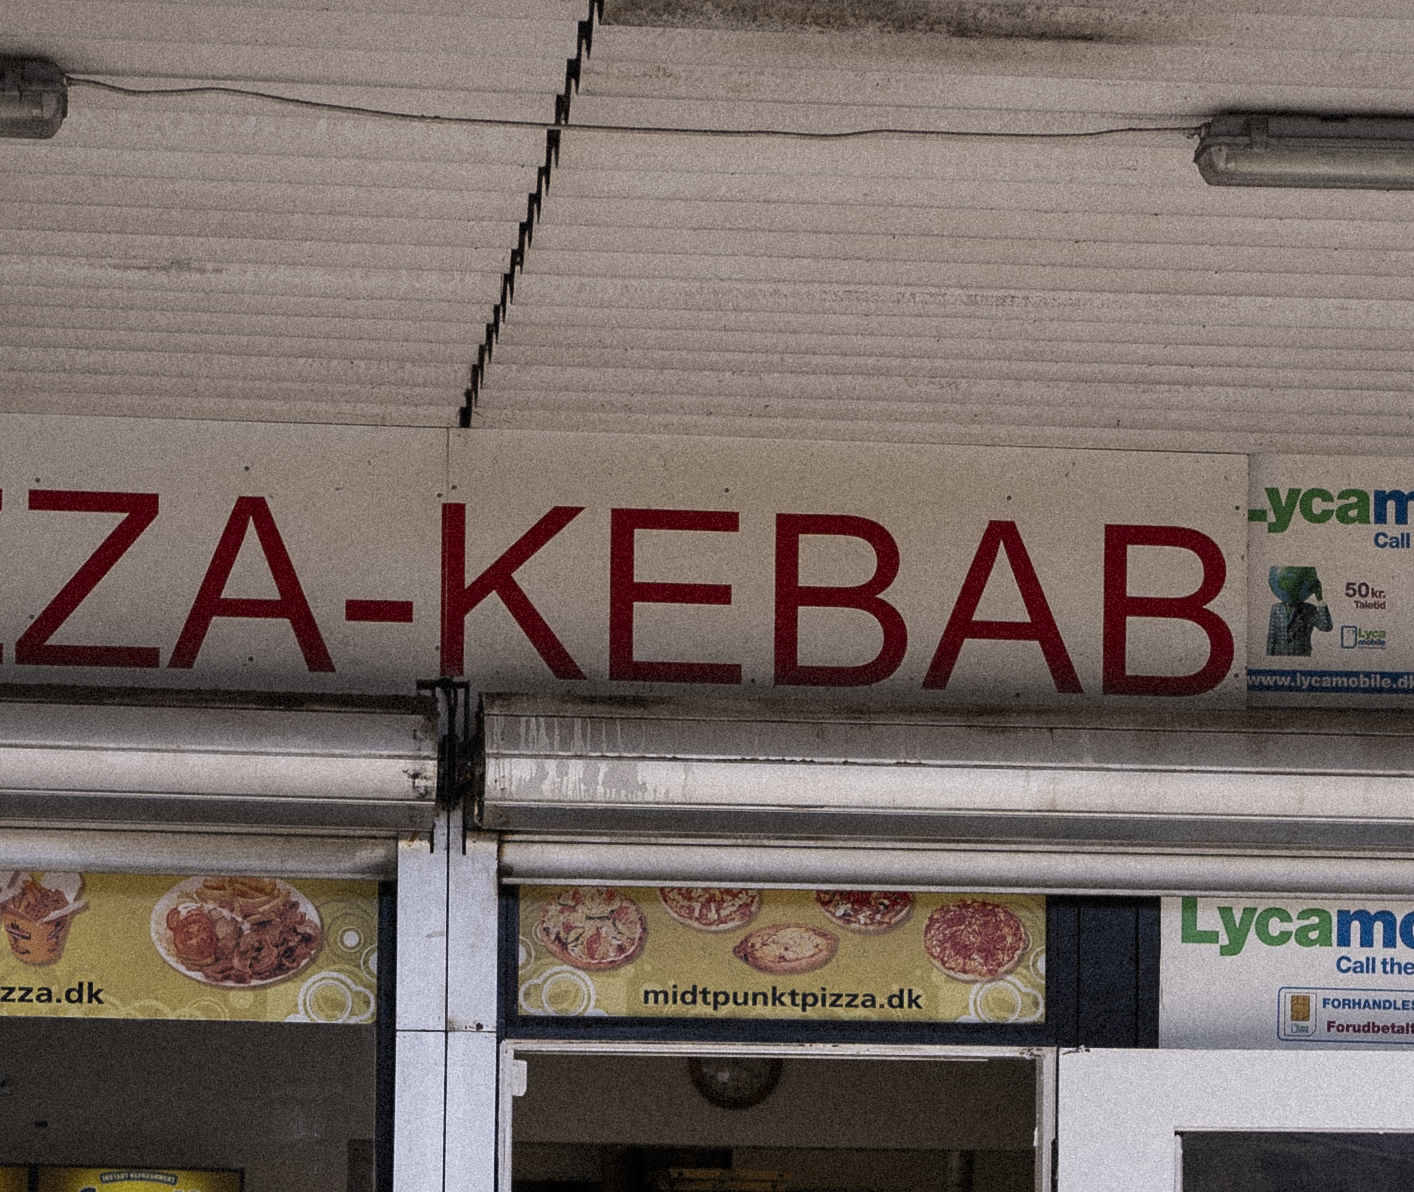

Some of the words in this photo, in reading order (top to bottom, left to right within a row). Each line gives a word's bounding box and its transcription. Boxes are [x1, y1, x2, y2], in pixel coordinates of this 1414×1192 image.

[1374, 532, 1410, 549] Call
[1345, 582, 1369, 598] 50
[1371, 588, 1386, 598] kr.
[1354, 600, 1386, 609] Taletid
[1358, 628, 1386, 640] Lyca
[1336, 955, 1376, 974] Call
[642, 984, 923, 1012] midtpunktpizza.dk
